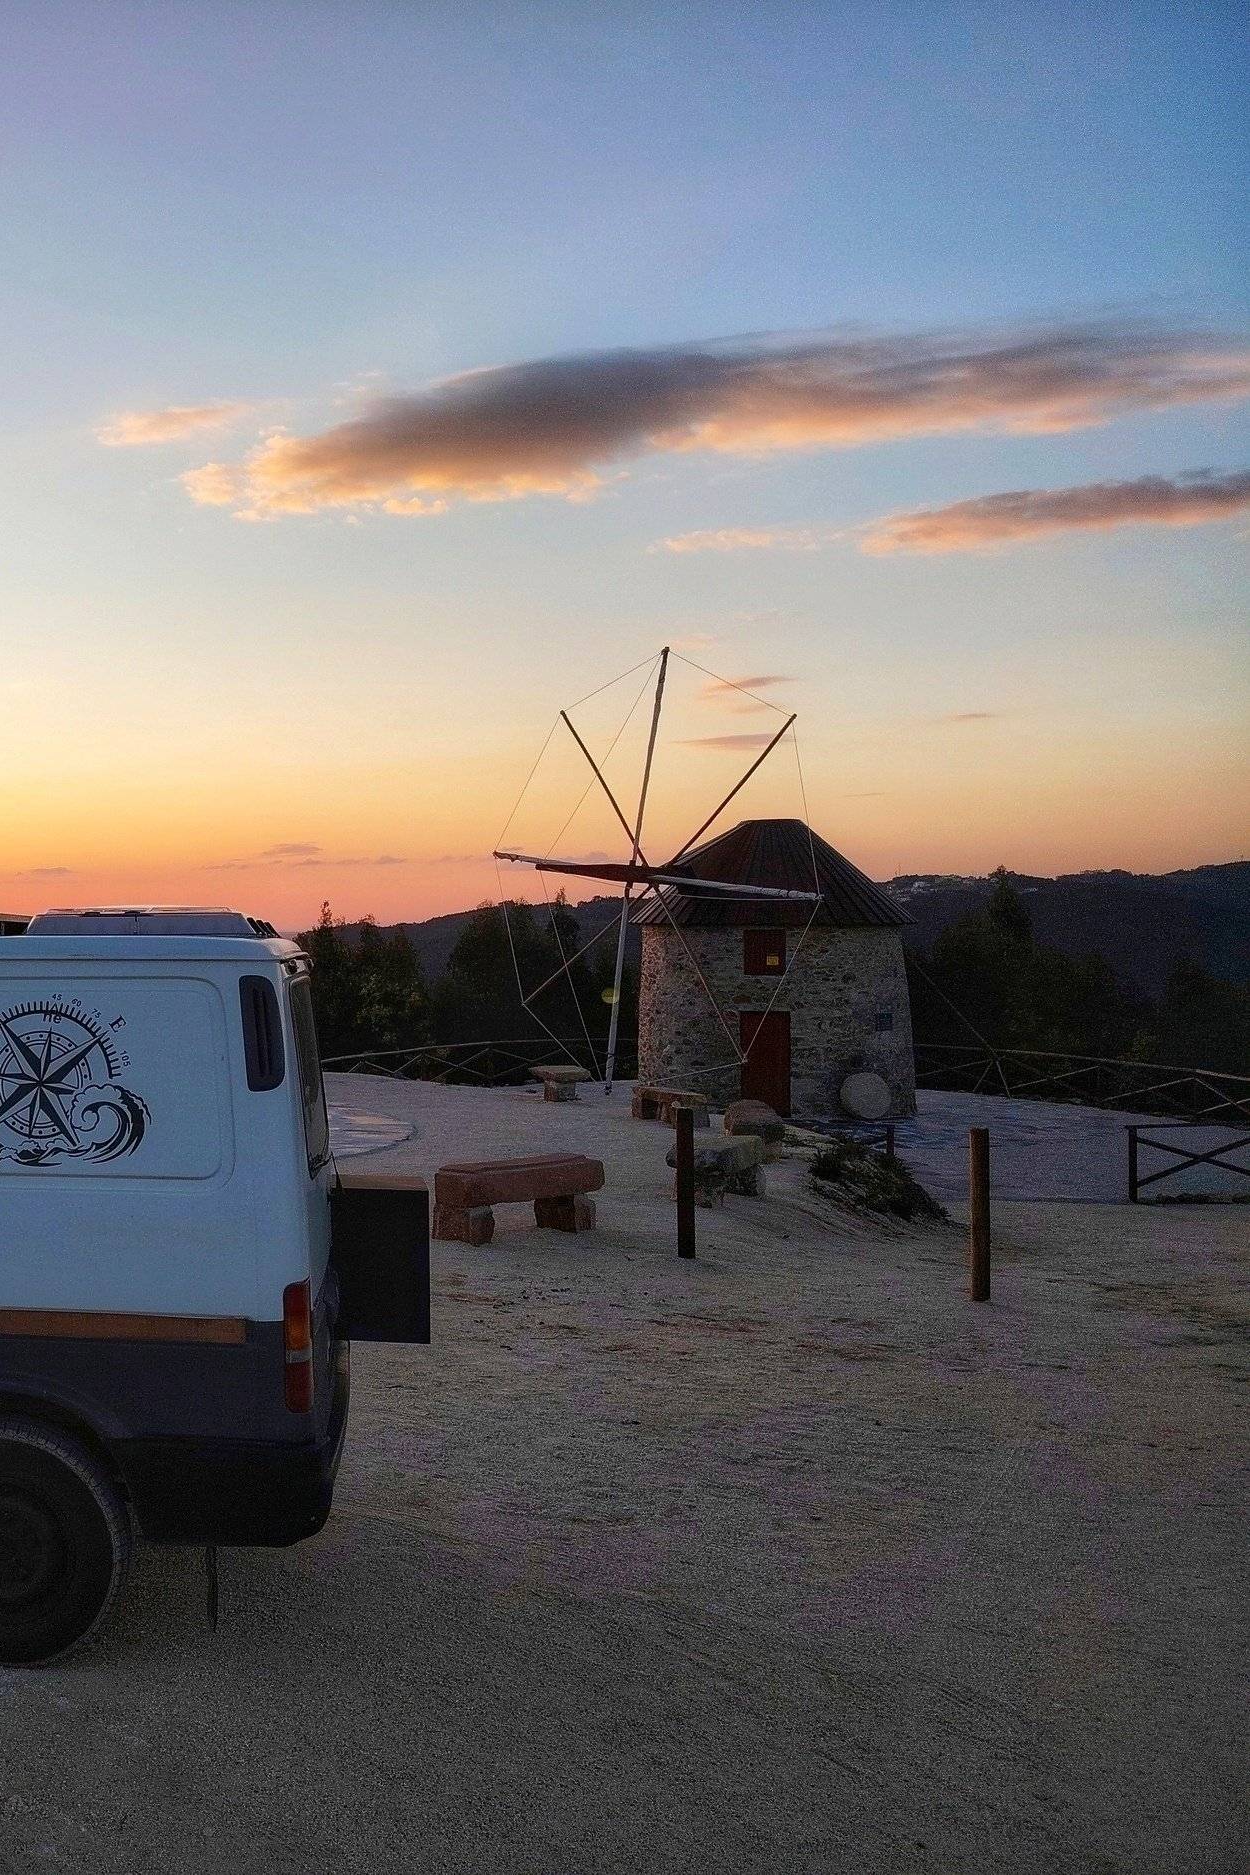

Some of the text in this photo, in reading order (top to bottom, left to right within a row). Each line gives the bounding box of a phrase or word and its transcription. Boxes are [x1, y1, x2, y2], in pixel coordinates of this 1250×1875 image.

[52, 993, 63, 1001] 45
[71, 998, 82, 1008] 60
[43, 1013, 62, 1024] ne
[91, 1008, 102, 1019] 75
[109, 1014, 127, 1034] E
[119, 1050, 132, 1067] 105
